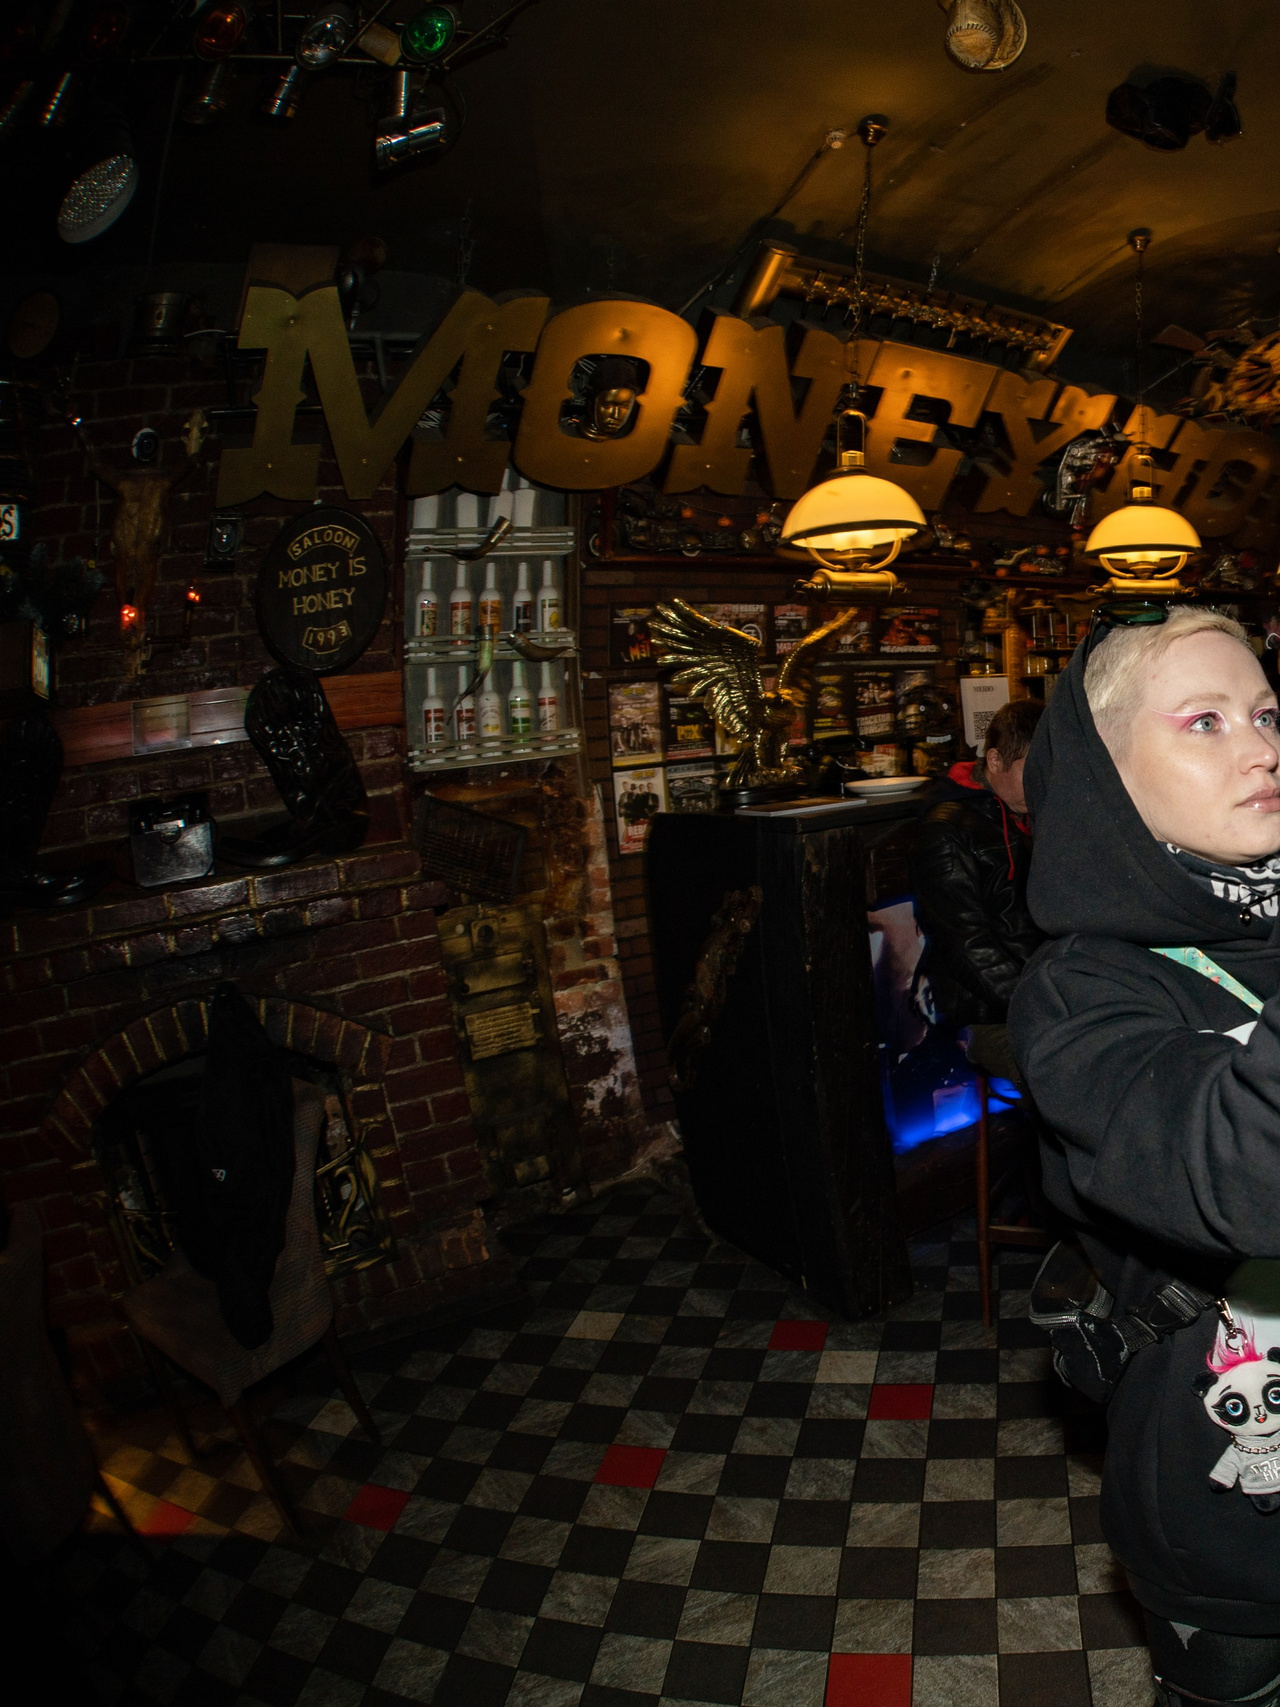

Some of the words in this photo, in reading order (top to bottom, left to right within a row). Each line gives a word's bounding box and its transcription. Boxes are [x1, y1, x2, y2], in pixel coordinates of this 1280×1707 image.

[216, 284, 1118, 517] MONEY
[291, 530, 355, 556] SALOON
[278, 561, 340, 589] MONEY
[348, 554, 368, 577] IS
[293, 586, 356, 616] HONEY
[308, 625, 348, 646] 1993
[973, 685, 994, 693] МЕНЮ
